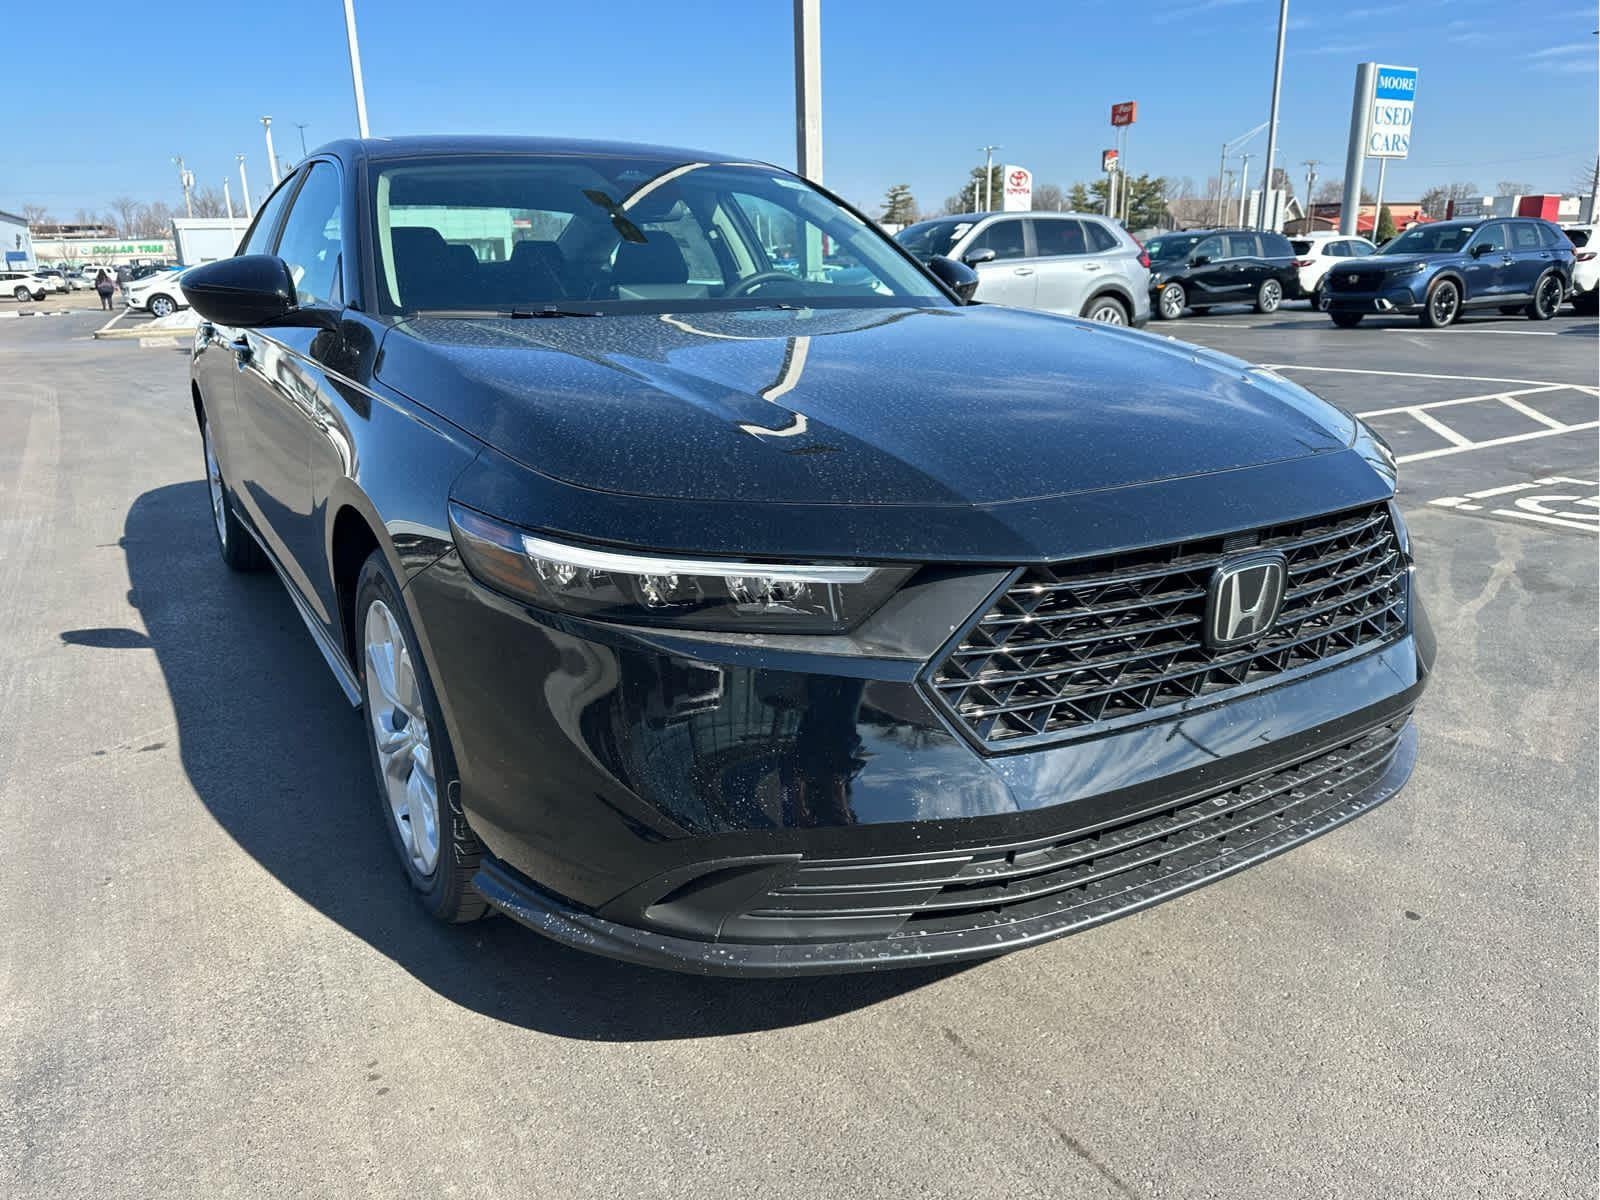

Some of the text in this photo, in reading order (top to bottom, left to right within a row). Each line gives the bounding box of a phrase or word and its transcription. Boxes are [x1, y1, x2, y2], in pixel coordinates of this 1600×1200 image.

[1378, 75, 1416, 91] MOORE
[1374, 106, 1412, 127] USED
[1370, 132, 1409, 153] CARS
[92, 244, 164, 255] DOLLAR TREE
